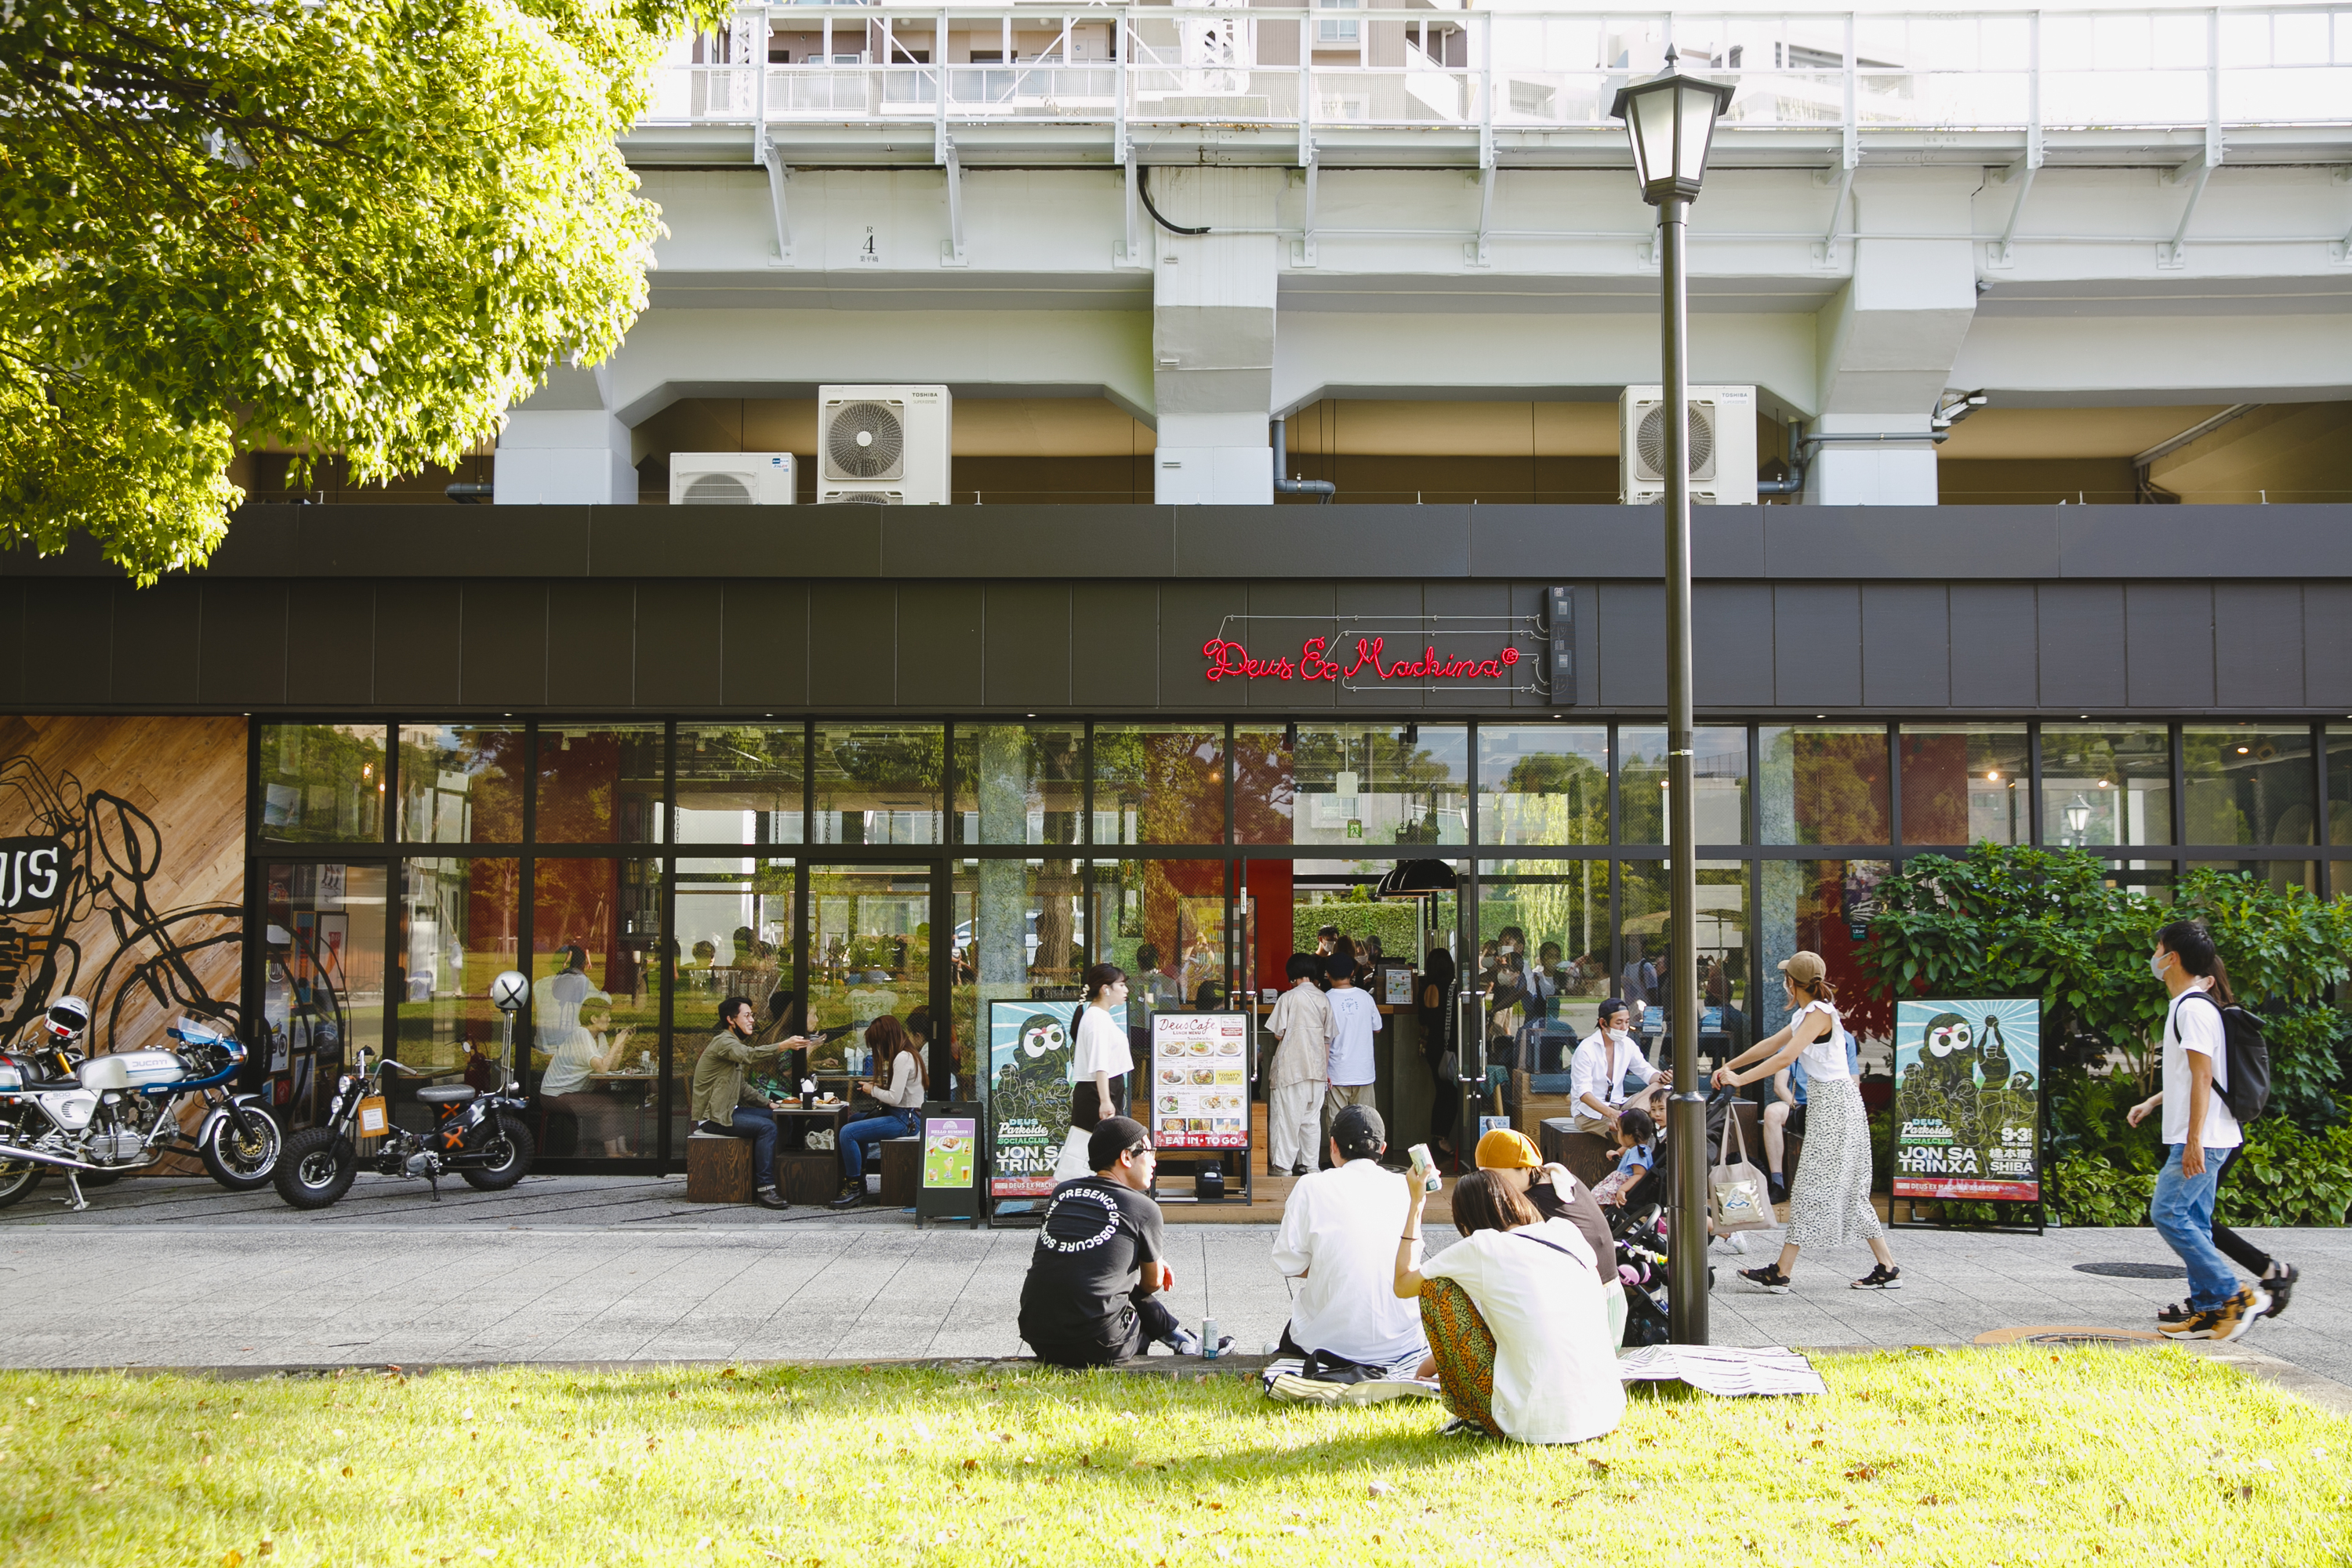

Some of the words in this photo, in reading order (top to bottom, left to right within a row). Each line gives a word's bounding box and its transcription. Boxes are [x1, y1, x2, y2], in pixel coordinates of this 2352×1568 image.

[862, 234, 876, 254] 4
[1203, 639, 1294, 681] Deus
[1299, 637, 1338, 681] Ex
[1160, 1018, 1189, 1031] Deus
[998, 1122, 1049, 1137] Parkside
[1900, 1121, 1954, 1137] Parkside
[996, 1145, 1039, 1159] JON
[1898, 1146, 1943, 1160] JON
[1947, 1147, 1978, 1160] SA
[996, 1158, 1058, 1171] TRINX
[1898, 1159, 1979, 1173] TRINXA
[1990, 1161, 2034, 1172] SHIBA
[1058, 1188, 1118, 1210] PRESENCE
[1109, 1211, 1120, 1226] OF
[1058, 1225, 1116, 1252] OBSCURE
